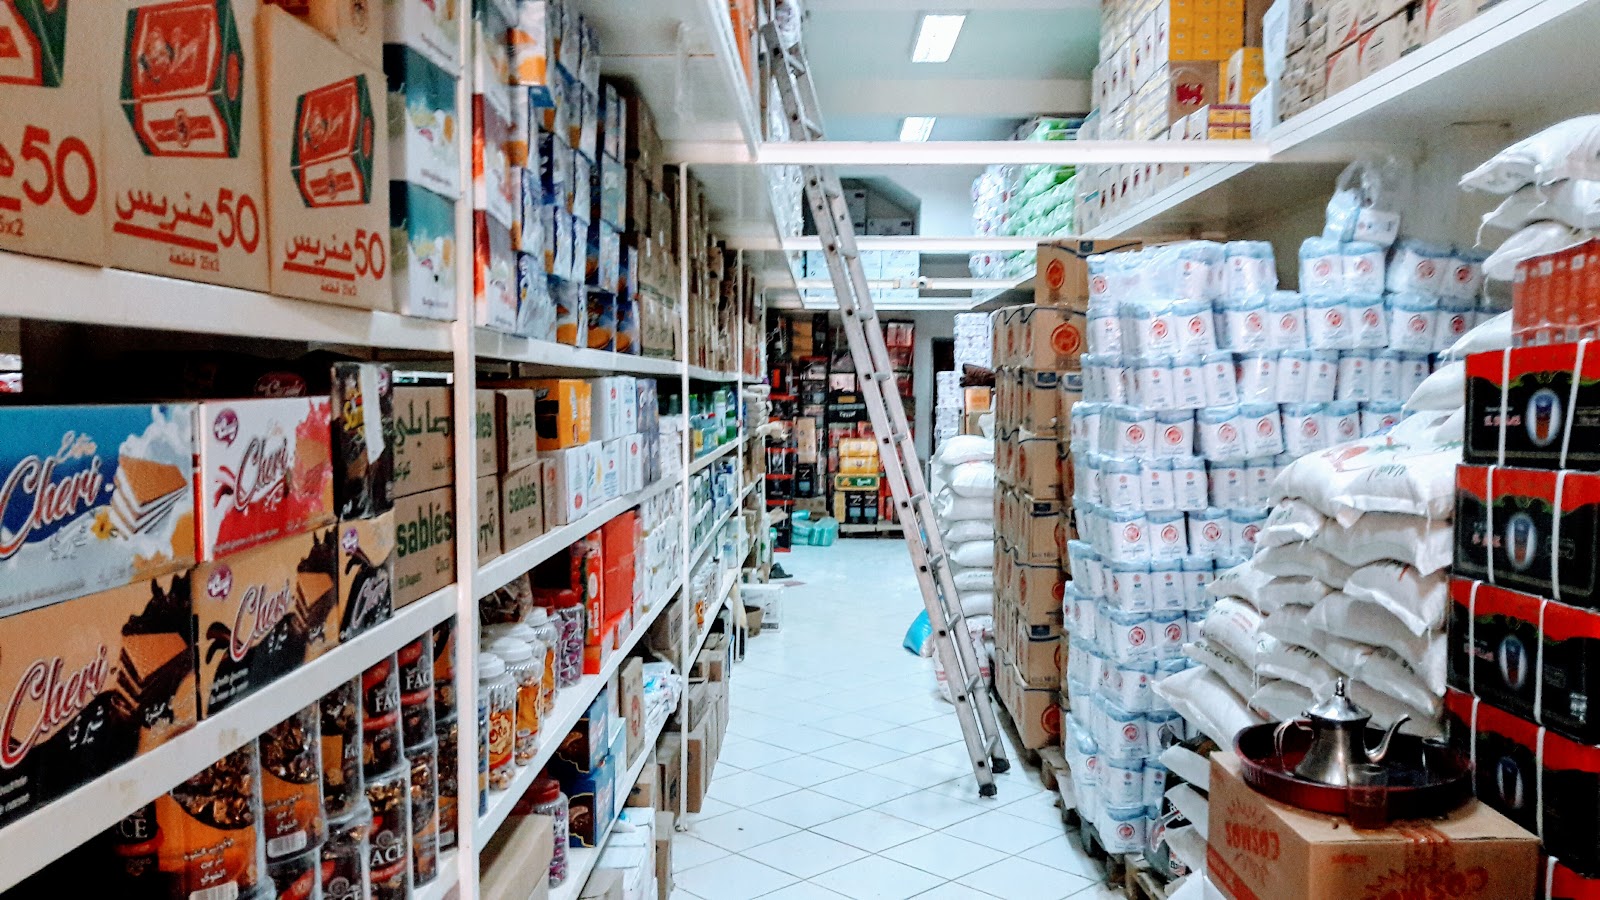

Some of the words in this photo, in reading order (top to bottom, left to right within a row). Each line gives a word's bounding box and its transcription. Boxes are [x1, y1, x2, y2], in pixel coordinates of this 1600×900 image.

[21, 125, 98, 216] 50
[217, 187, 260, 254] 50
[355, 228, 385, 280] 50
[0, 455, 103, 561] Cheri
[397, 502, 451, 558] sablés
[0, 643, 108, 770] Cheri
